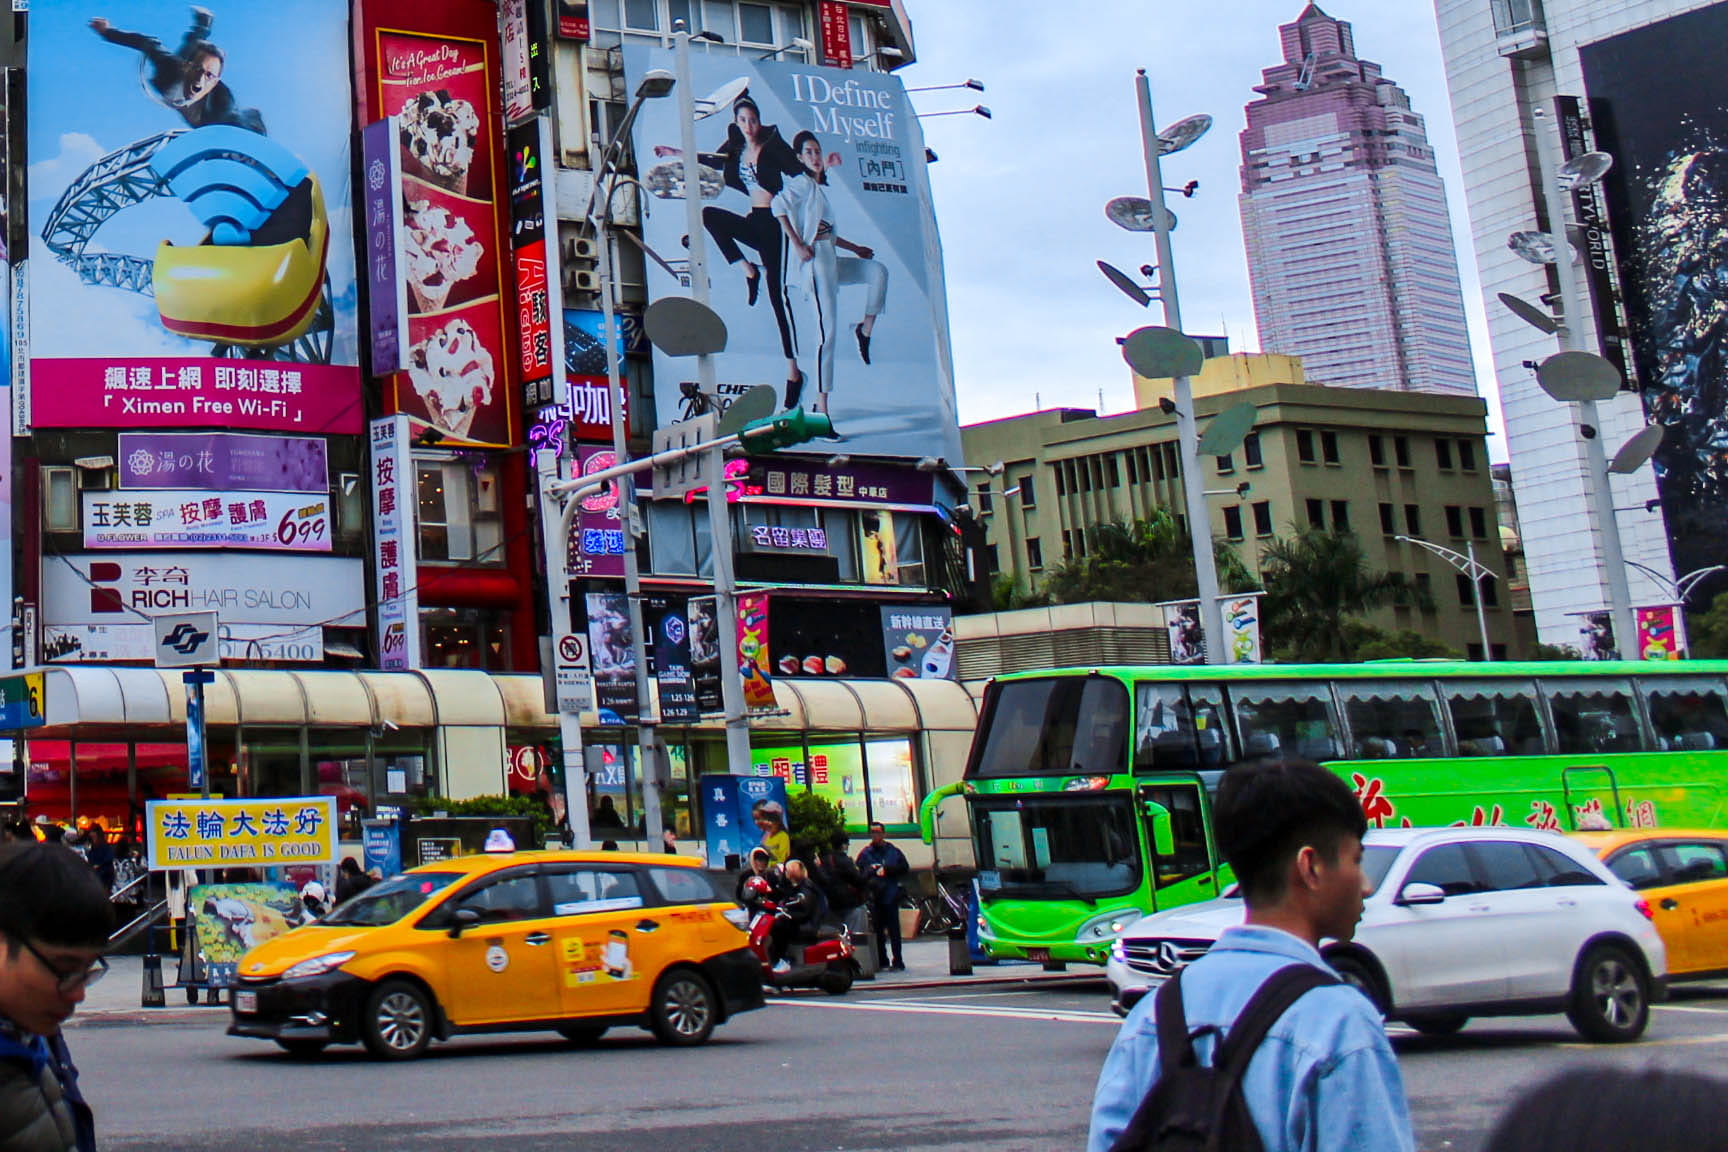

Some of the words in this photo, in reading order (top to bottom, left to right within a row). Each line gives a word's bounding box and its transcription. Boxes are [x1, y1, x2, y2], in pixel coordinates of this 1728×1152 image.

[792, 74, 802, 102] I
[808, 75, 891, 110] Define
[813, 105, 894, 143] Myself
[215, 366, 303, 396] 即刻選擇
[122, 397, 186, 416] Ximen
[192, 396, 233, 415] Free
[237, 397, 288, 419] Wi-Fi
[156, 449, 215, 474] 湯の花
[376, 457, 396, 517] 按摩
[767, 470, 855, 498] 國際髮型
[92, 502, 153, 529] 玉芙蓉
[156, 510, 176, 521] SPA
[179, 497, 224, 525] 按摩
[227, 499, 268, 526] 護膚
[379, 540, 399, 601] 護膚
[132, 590, 189, 609] RICH
[190, 589, 239, 608] HAIR
[245, 589, 312, 610] SALON
[29, 686, 38, 718] 6
[162, 807, 324, 840] 法輪大法好
[167, 844, 214, 861] FALUN
[220, 844, 257, 860] DAFA
[261, 843, 275, 858] IS
[280, 841, 322, 857] GOOD
